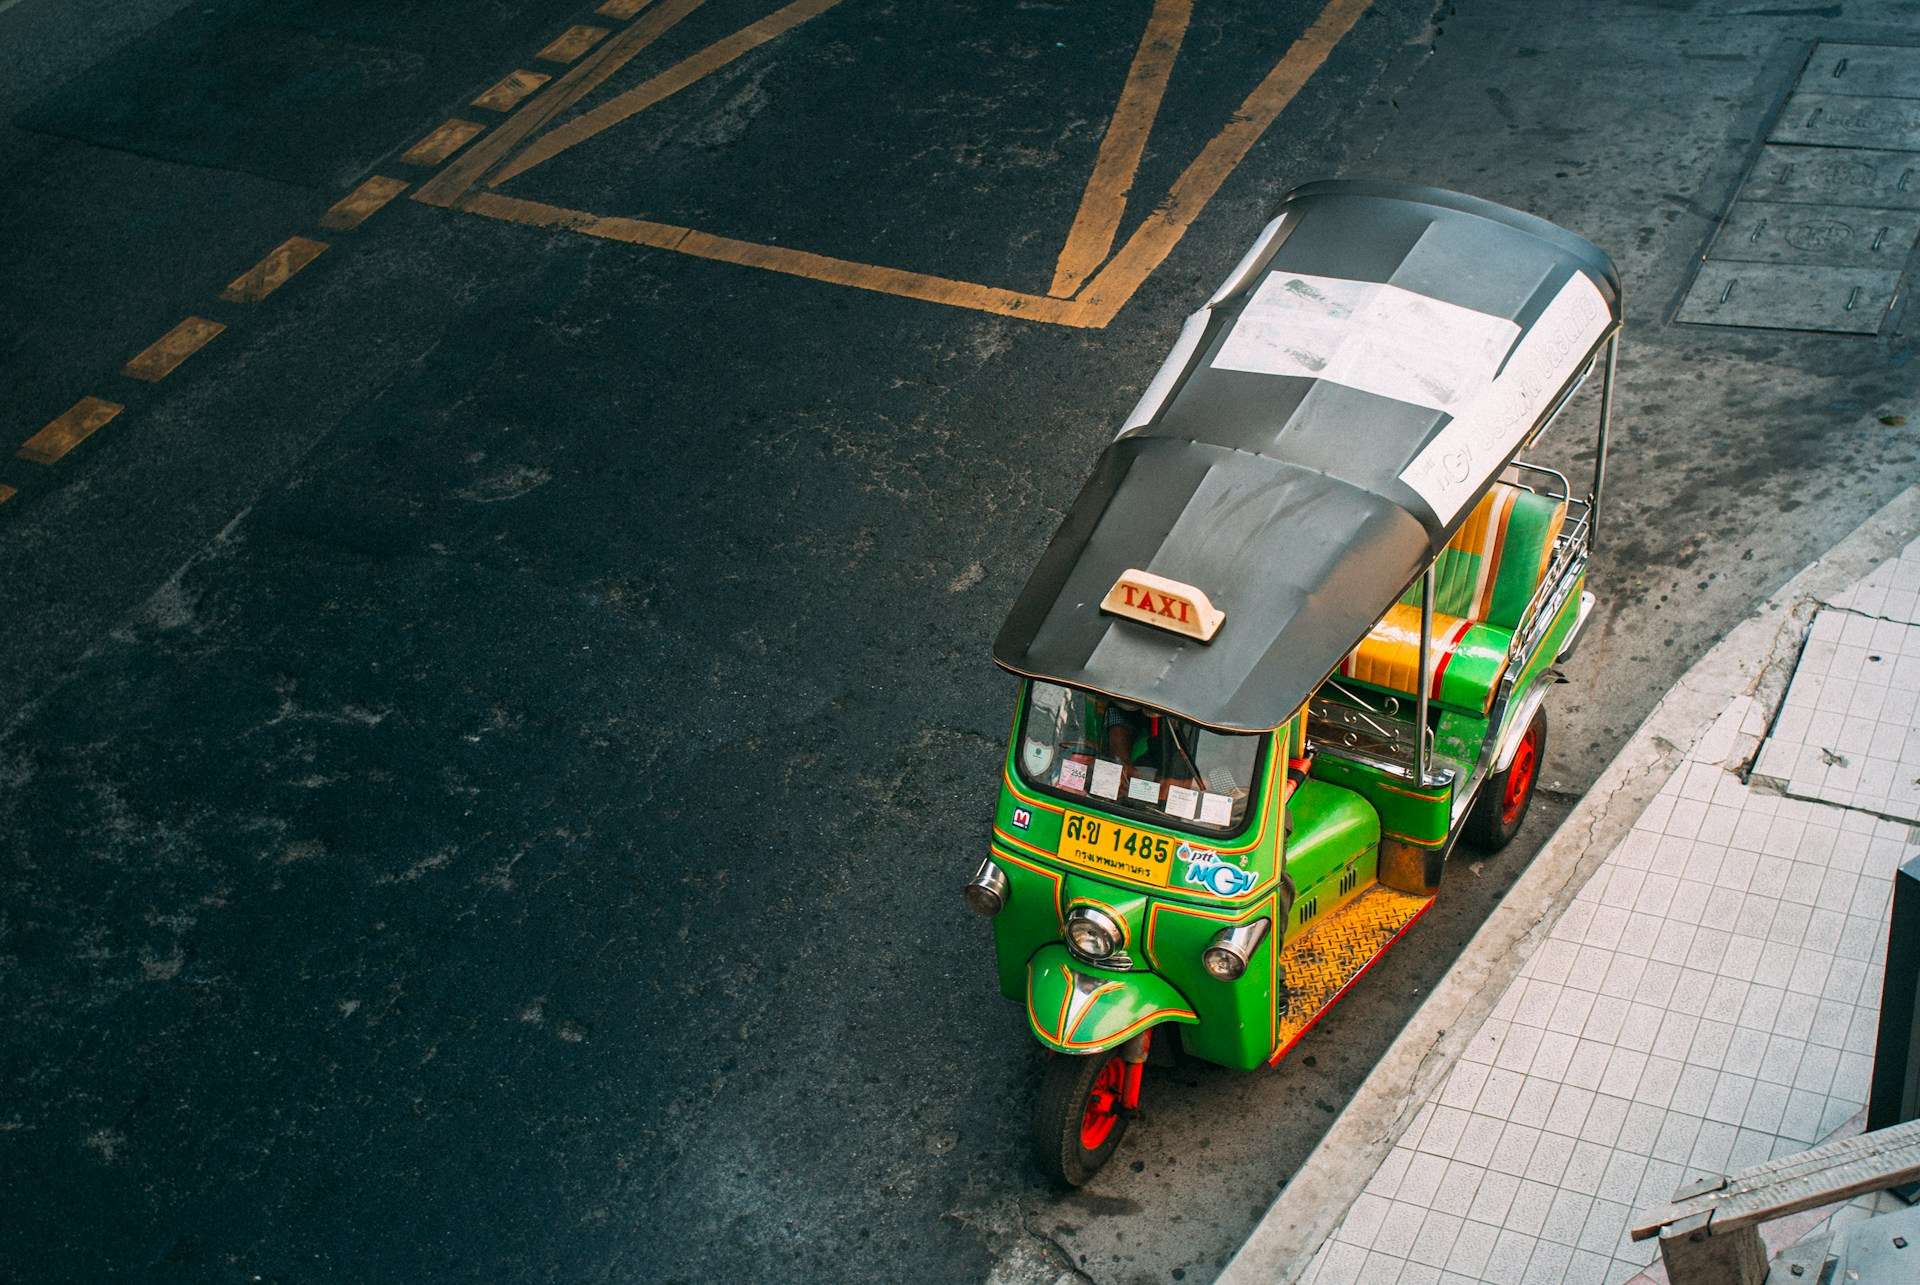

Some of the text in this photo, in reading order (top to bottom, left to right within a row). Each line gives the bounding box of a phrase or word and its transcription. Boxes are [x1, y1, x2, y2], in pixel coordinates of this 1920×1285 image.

[1121, 584, 1190, 624] TAXI
[1074, 848, 1152, 878] กรุงเทพมหานคร
[1113, 831, 1170, 864] 1485
[1191, 850, 1214, 862] ptt
[1188, 863, 1257, 896] NGV
